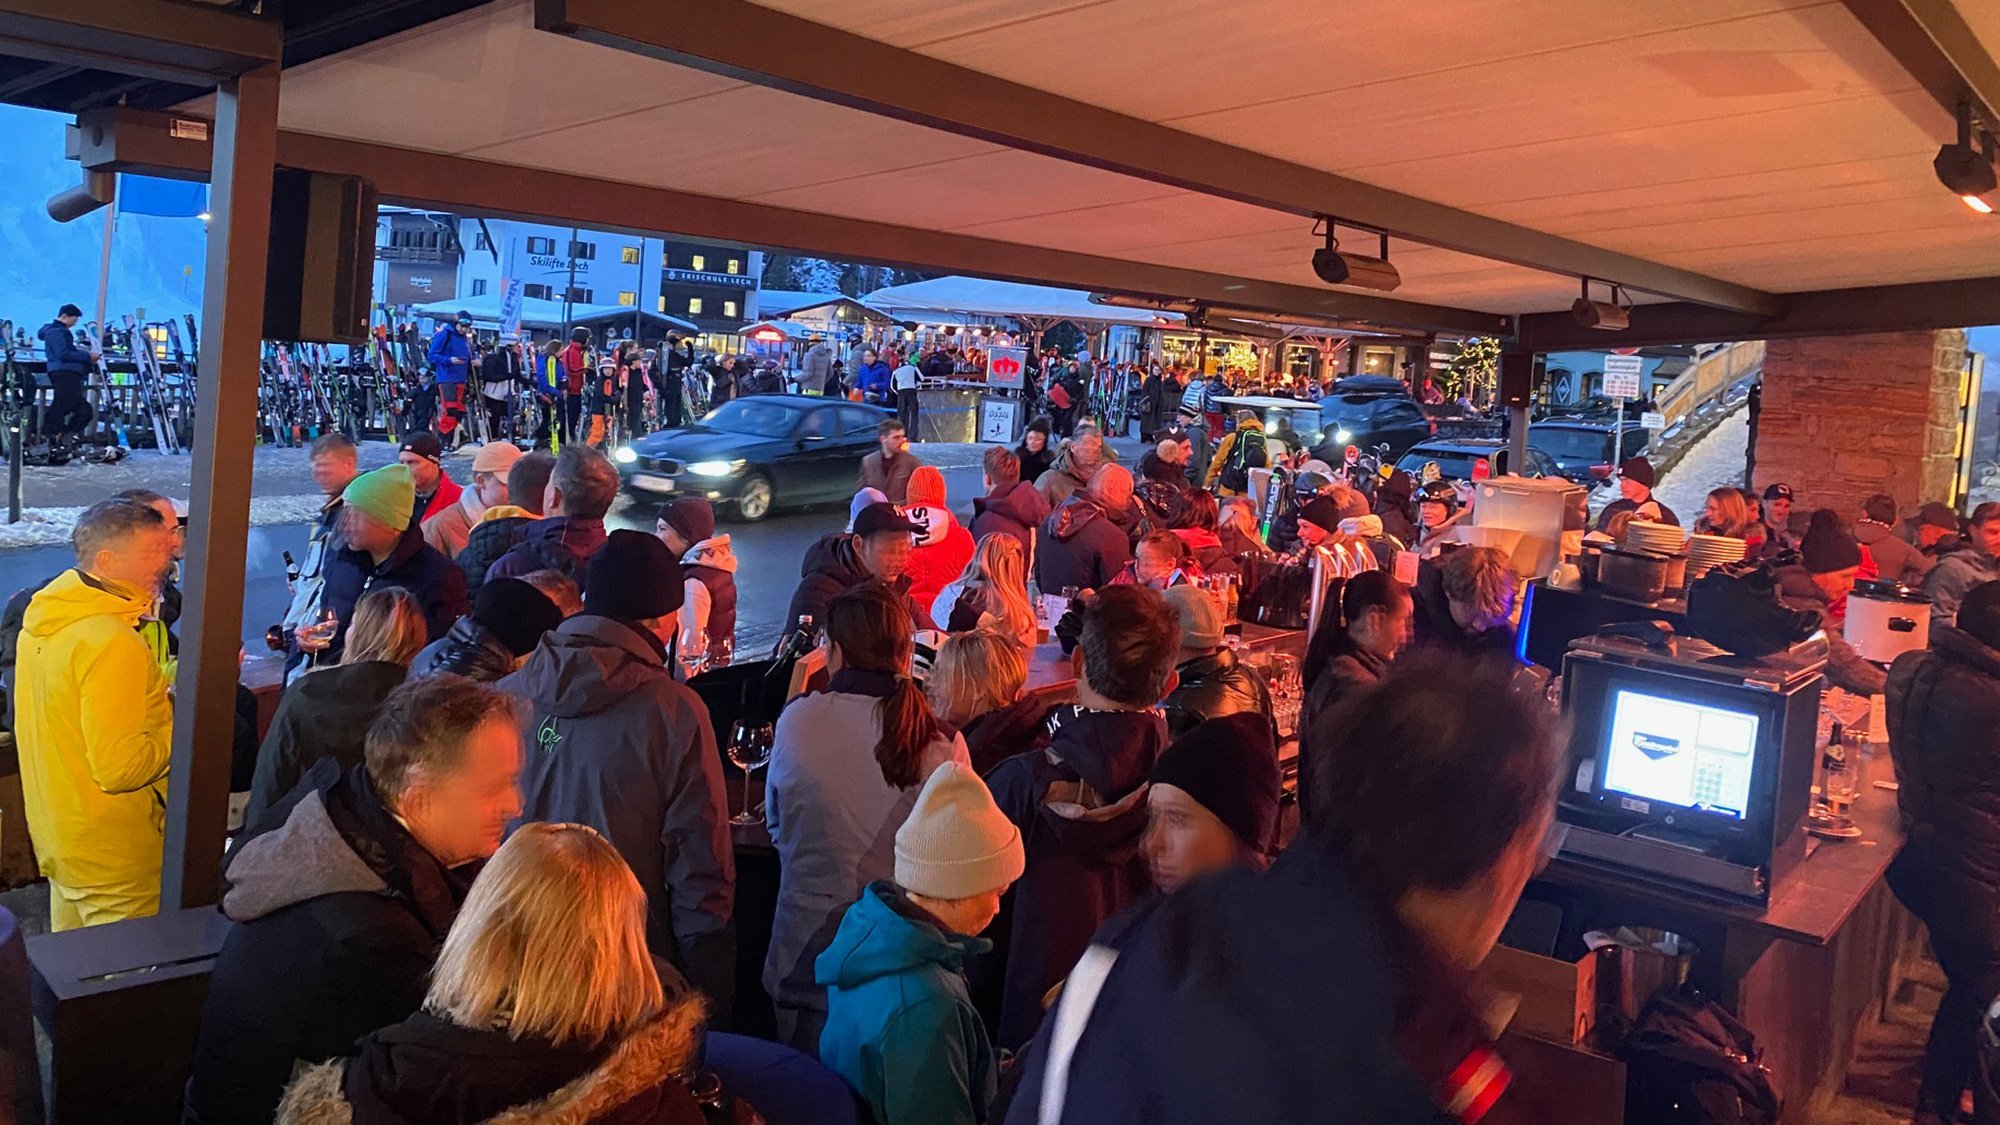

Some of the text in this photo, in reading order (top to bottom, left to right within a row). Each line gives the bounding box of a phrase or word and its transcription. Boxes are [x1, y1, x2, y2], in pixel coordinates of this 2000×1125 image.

[530, 255, 566, 270] Skilifte
[681, 272, 752, 285] SKISCHULE LECH
[1264, 484, 1280, 524] HEAD
